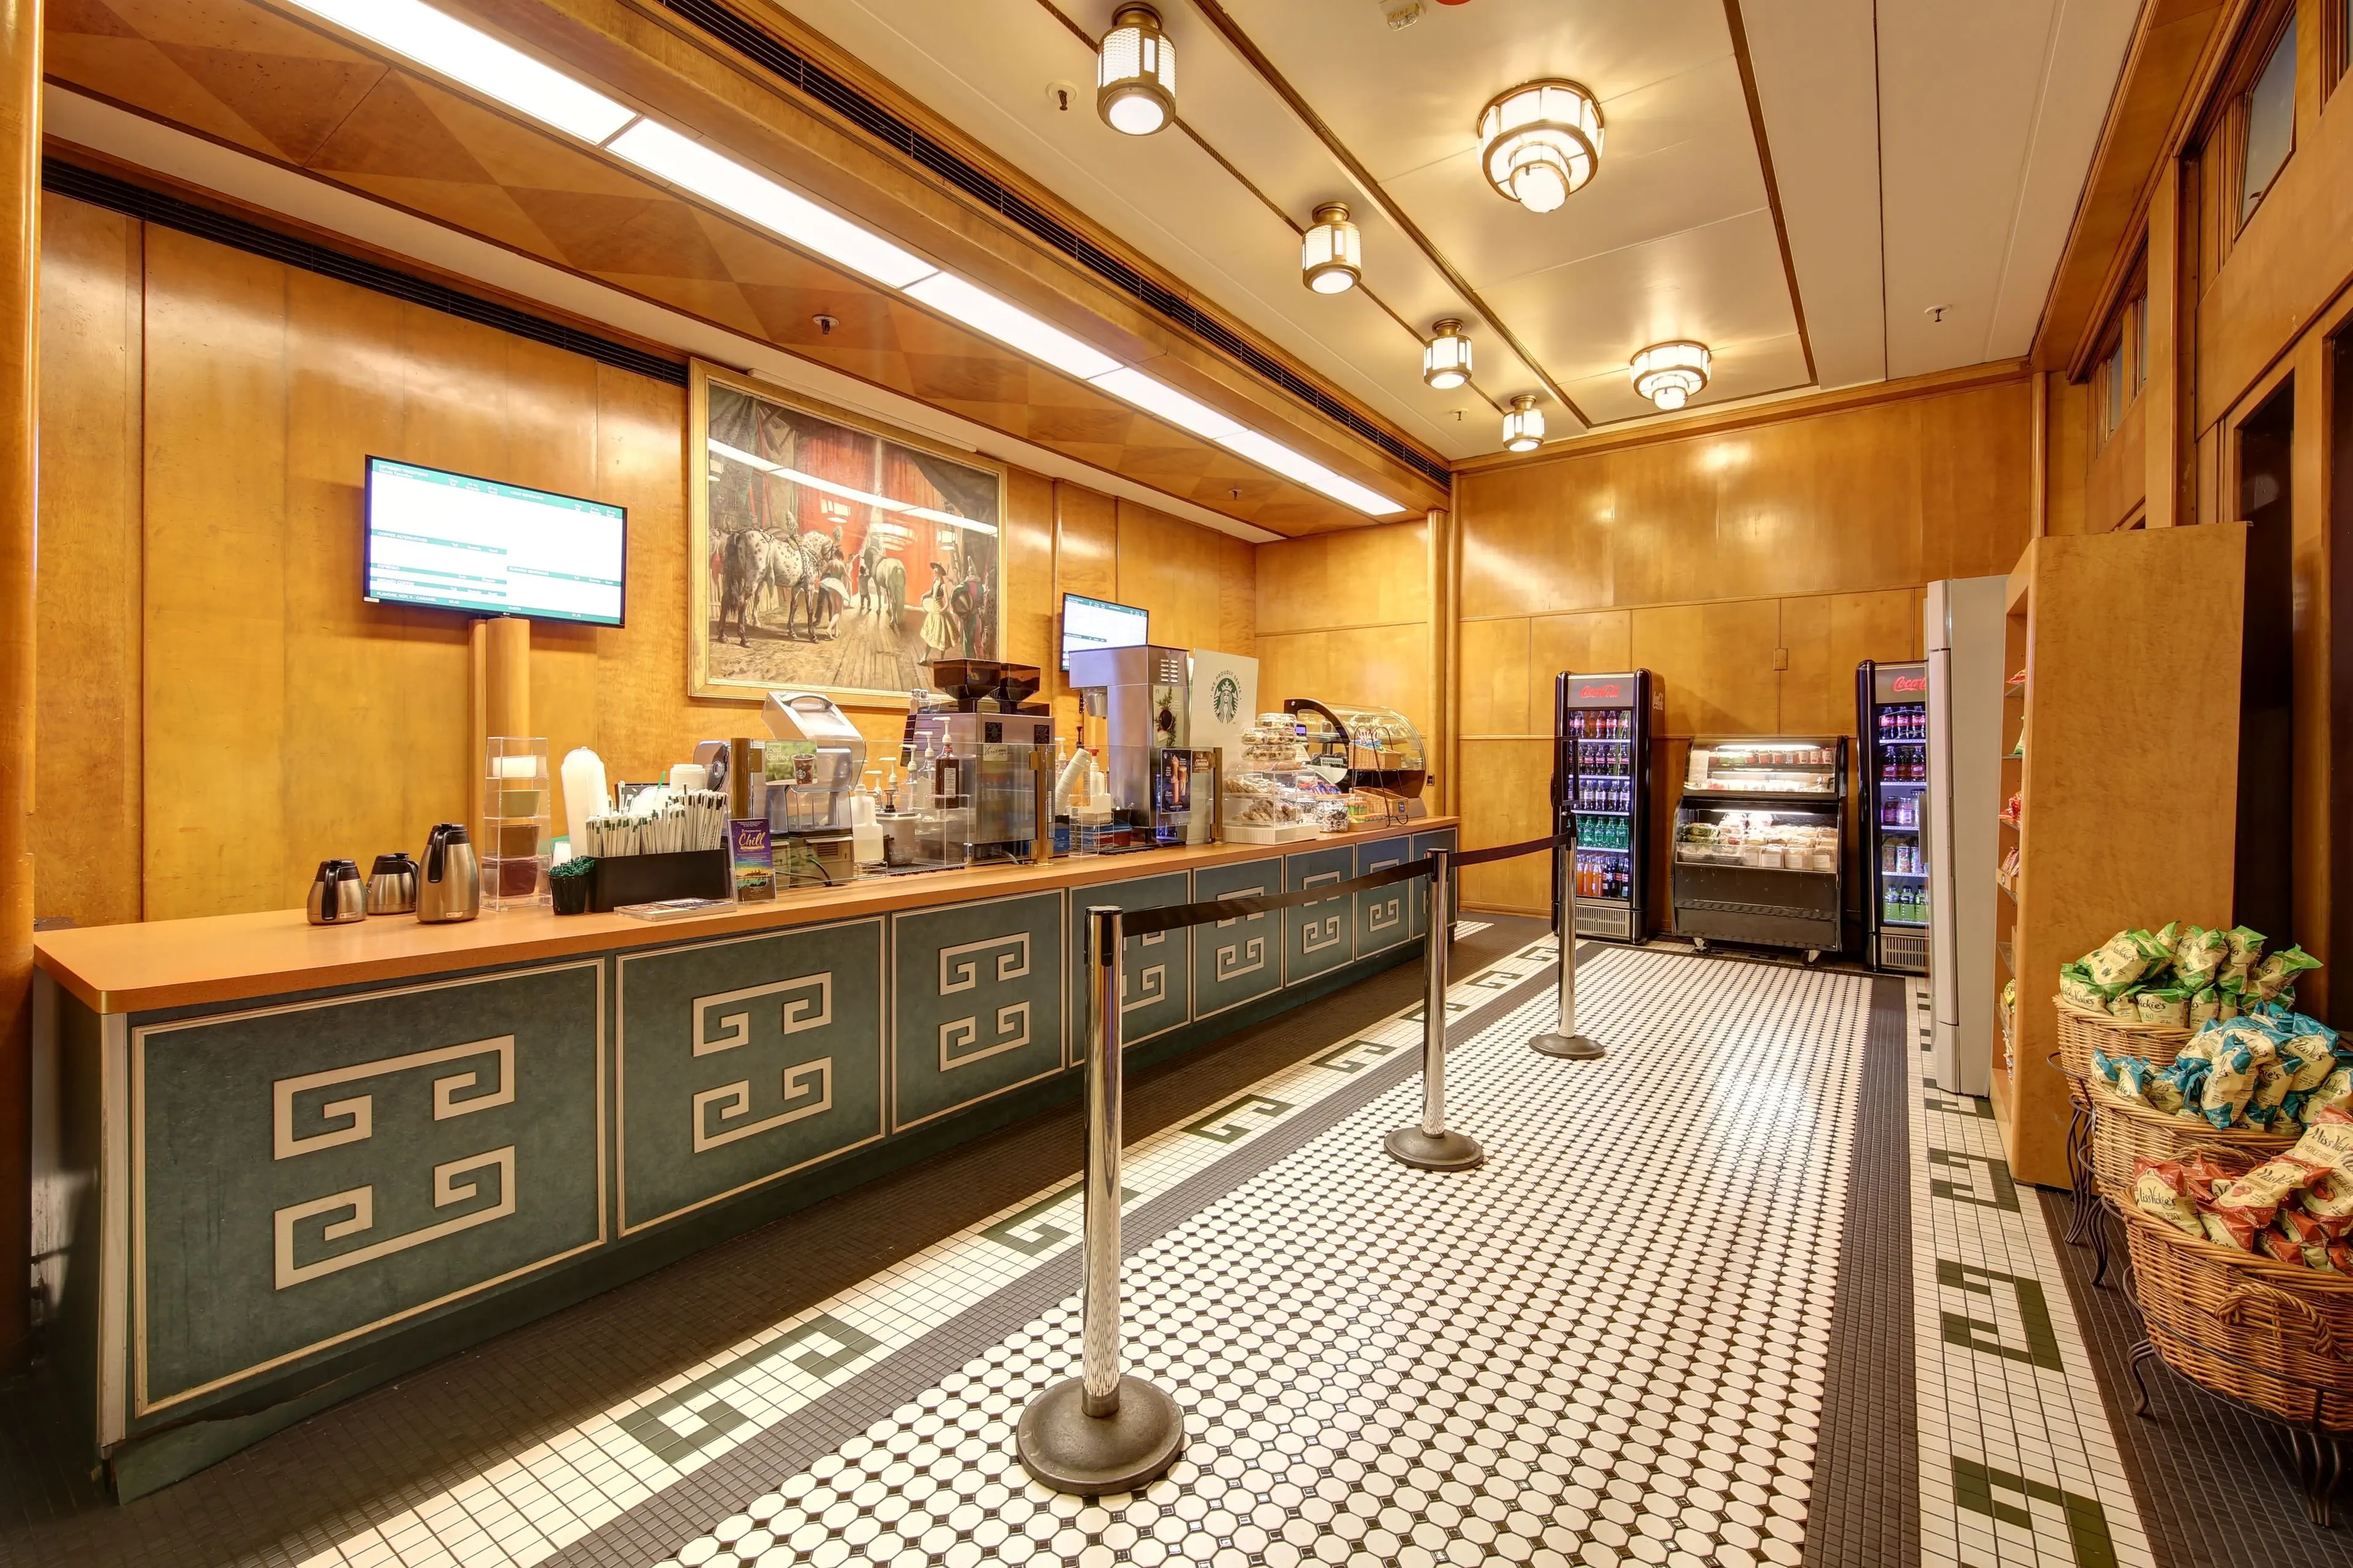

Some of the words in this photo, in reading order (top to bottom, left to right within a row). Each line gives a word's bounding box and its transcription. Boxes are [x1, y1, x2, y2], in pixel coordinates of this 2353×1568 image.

[1392, 8, 1409, 18] FIRE
[1211, 681, 1216, 691] WE
[1216, 670, 1233, 680] PROUDLY
[1892, 676, 1927, 692] Coca-C
[767, 744, 781, 753] Iced
[738, 831, 766, 846] Chill
[2304, 1127, 2334, 1147] Miss
